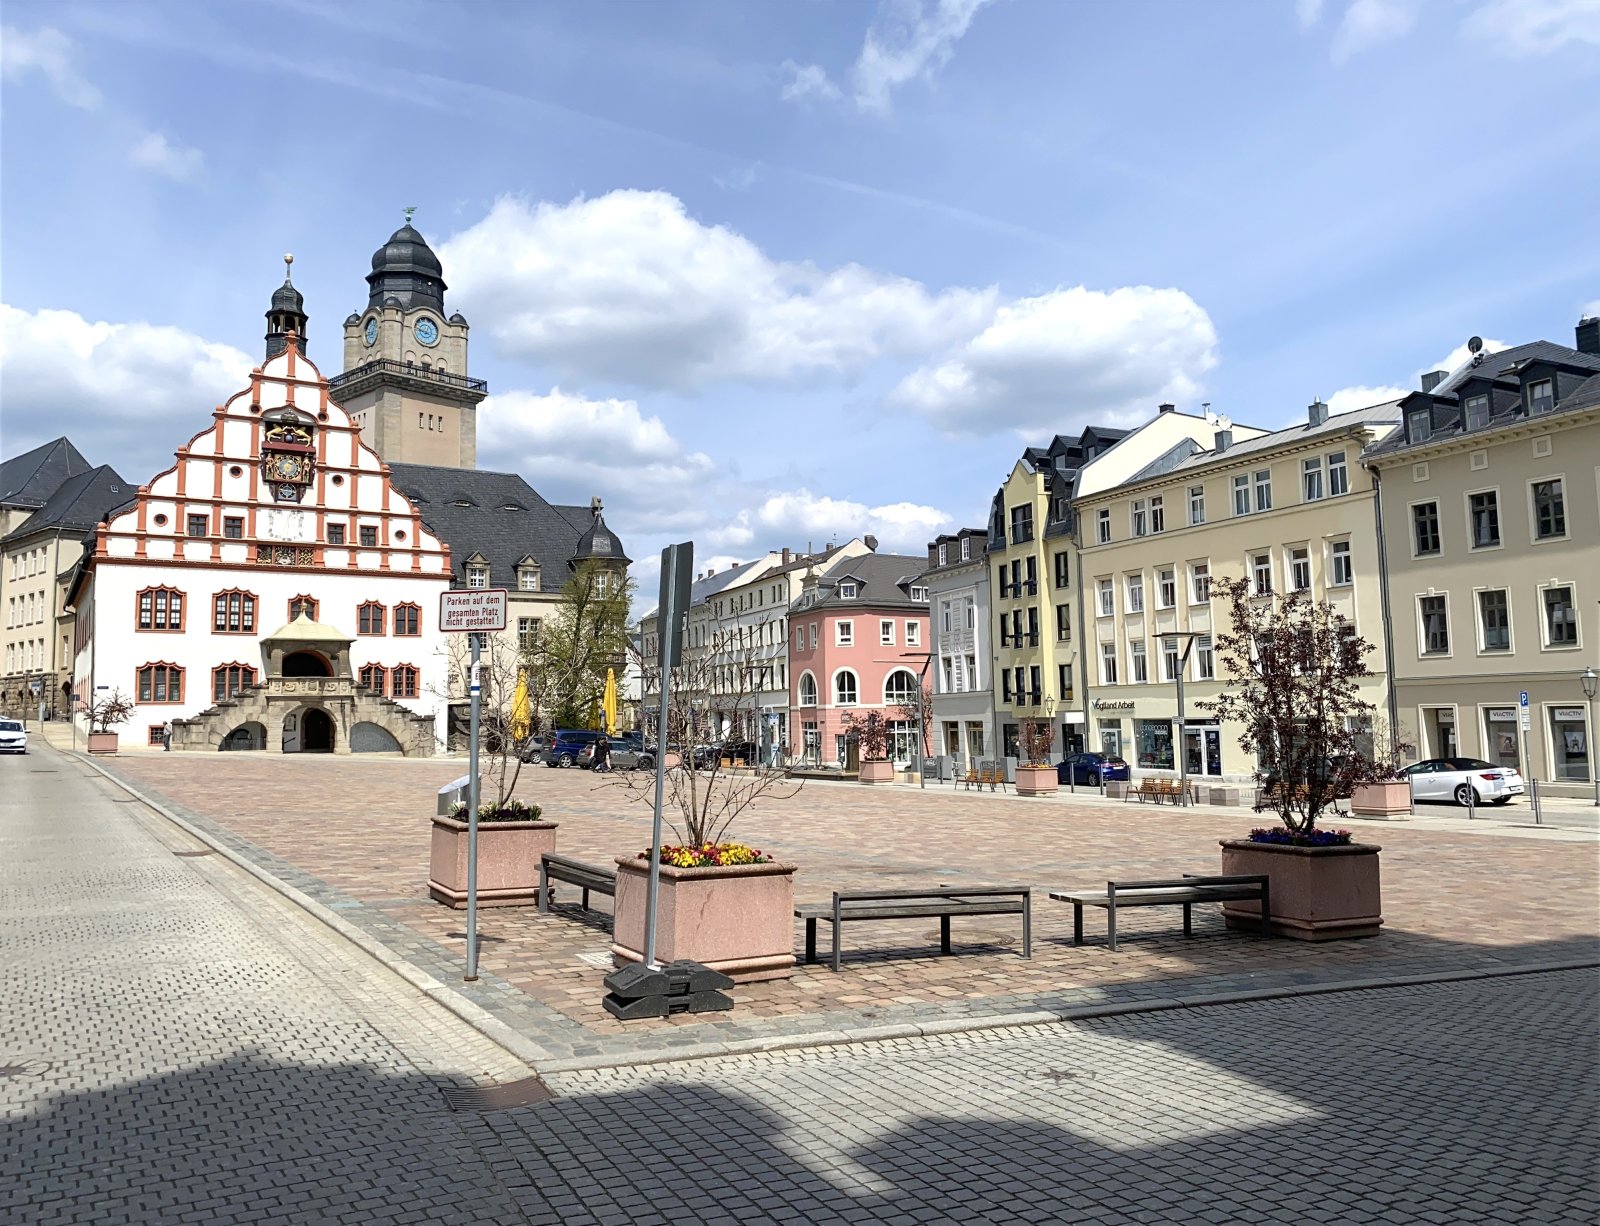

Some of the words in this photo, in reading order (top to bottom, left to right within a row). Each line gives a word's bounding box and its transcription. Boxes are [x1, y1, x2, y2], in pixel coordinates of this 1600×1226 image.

[447, 597, 470, 605] Parken
[473, 596, 483, 604] auf
[486, 596, 500, 604] dem
[448, 608, 479, 619] gesamten
[482, 607, 498, 616] Platz
[446, 617, 462, 626] nicht
[466, 617, 494, 627] gestattet
[1092, 698, 1117, 711] Vogtland
[1118, 701, 1135, 709] Arbeit
